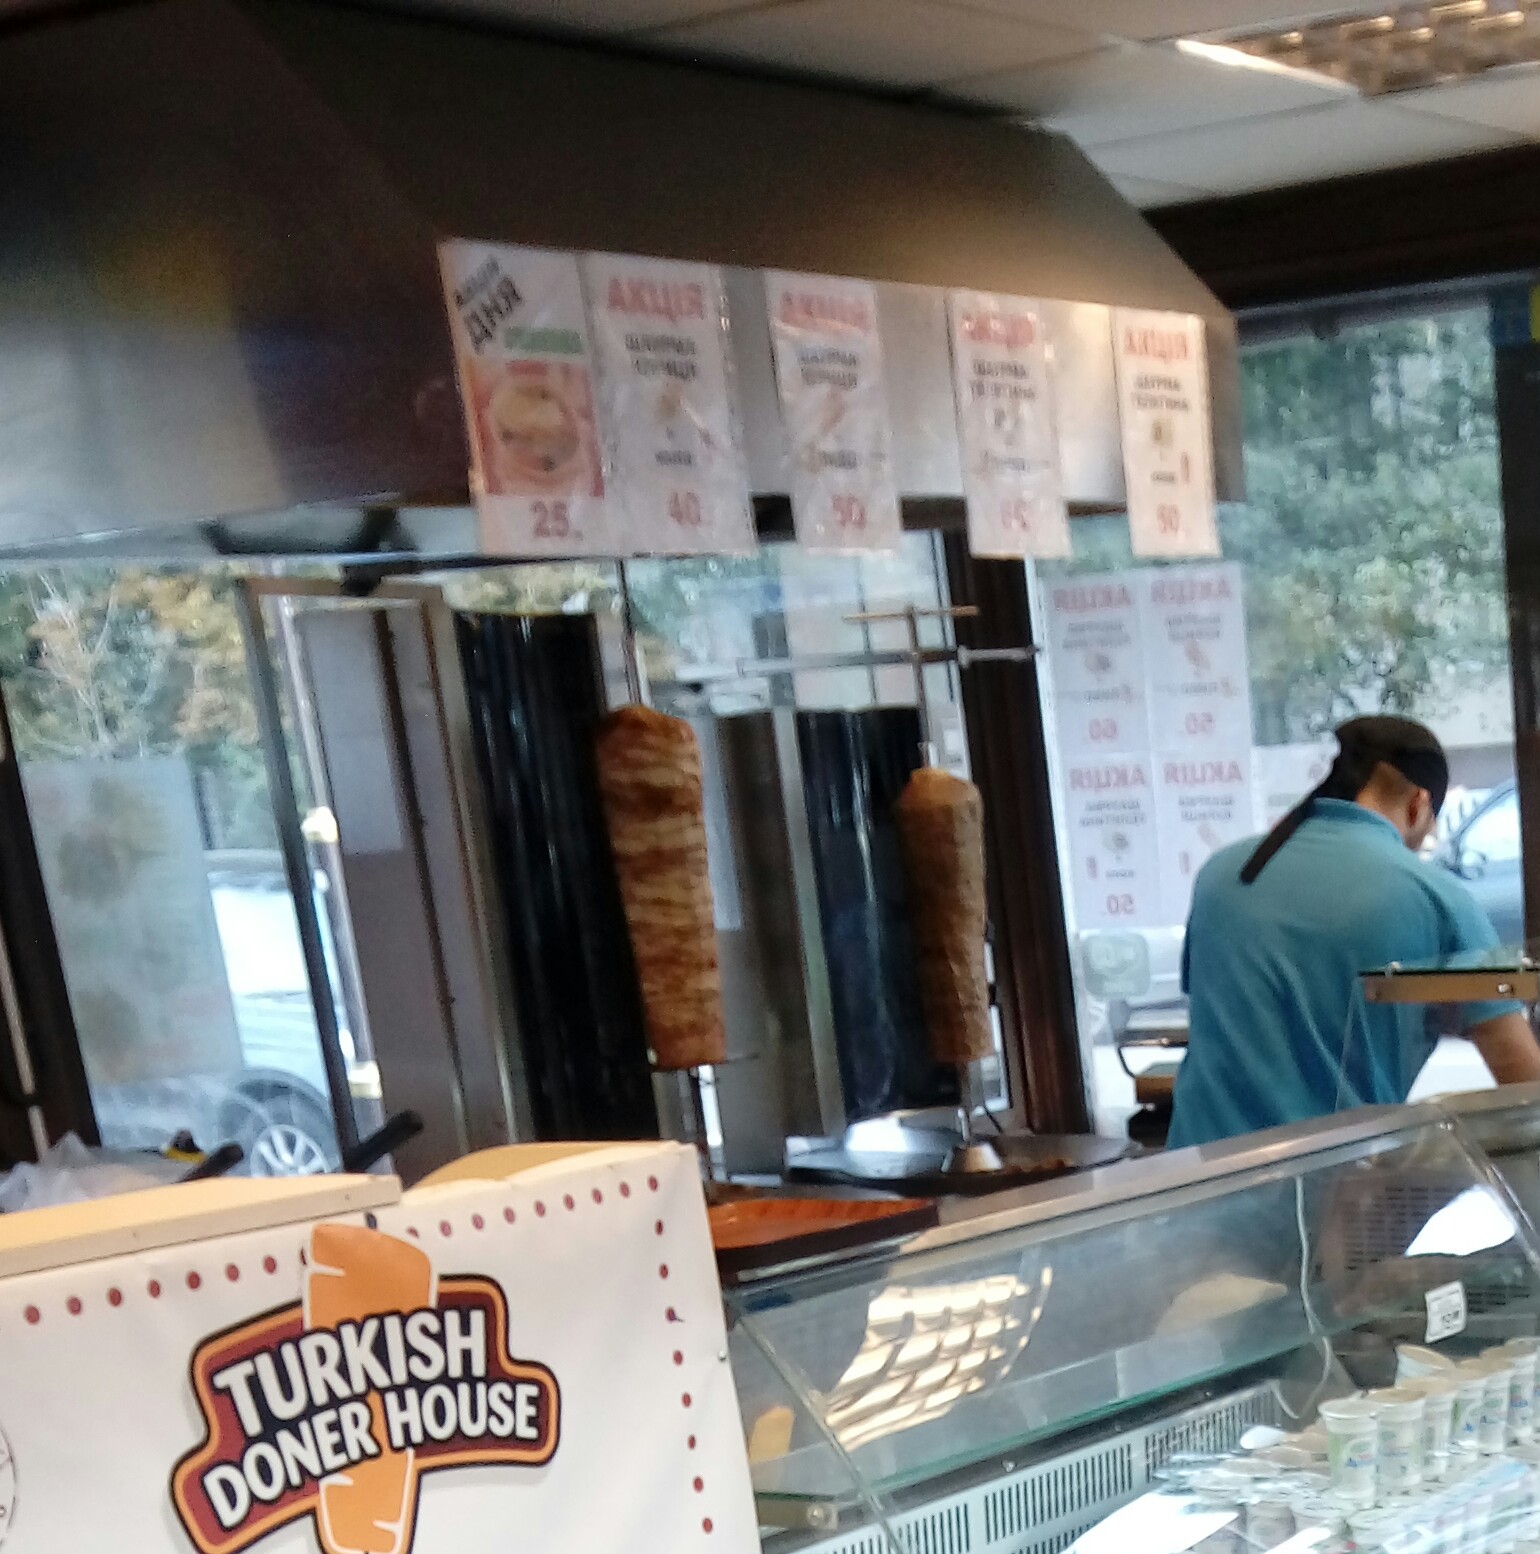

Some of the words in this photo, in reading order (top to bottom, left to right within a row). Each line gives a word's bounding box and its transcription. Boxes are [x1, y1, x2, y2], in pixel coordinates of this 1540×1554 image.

[212, 1308, 488, 1438] TURKISH
[202, 1397, 380, 1529] DONER
[384, 1381, 541, 1450] HOUSE
